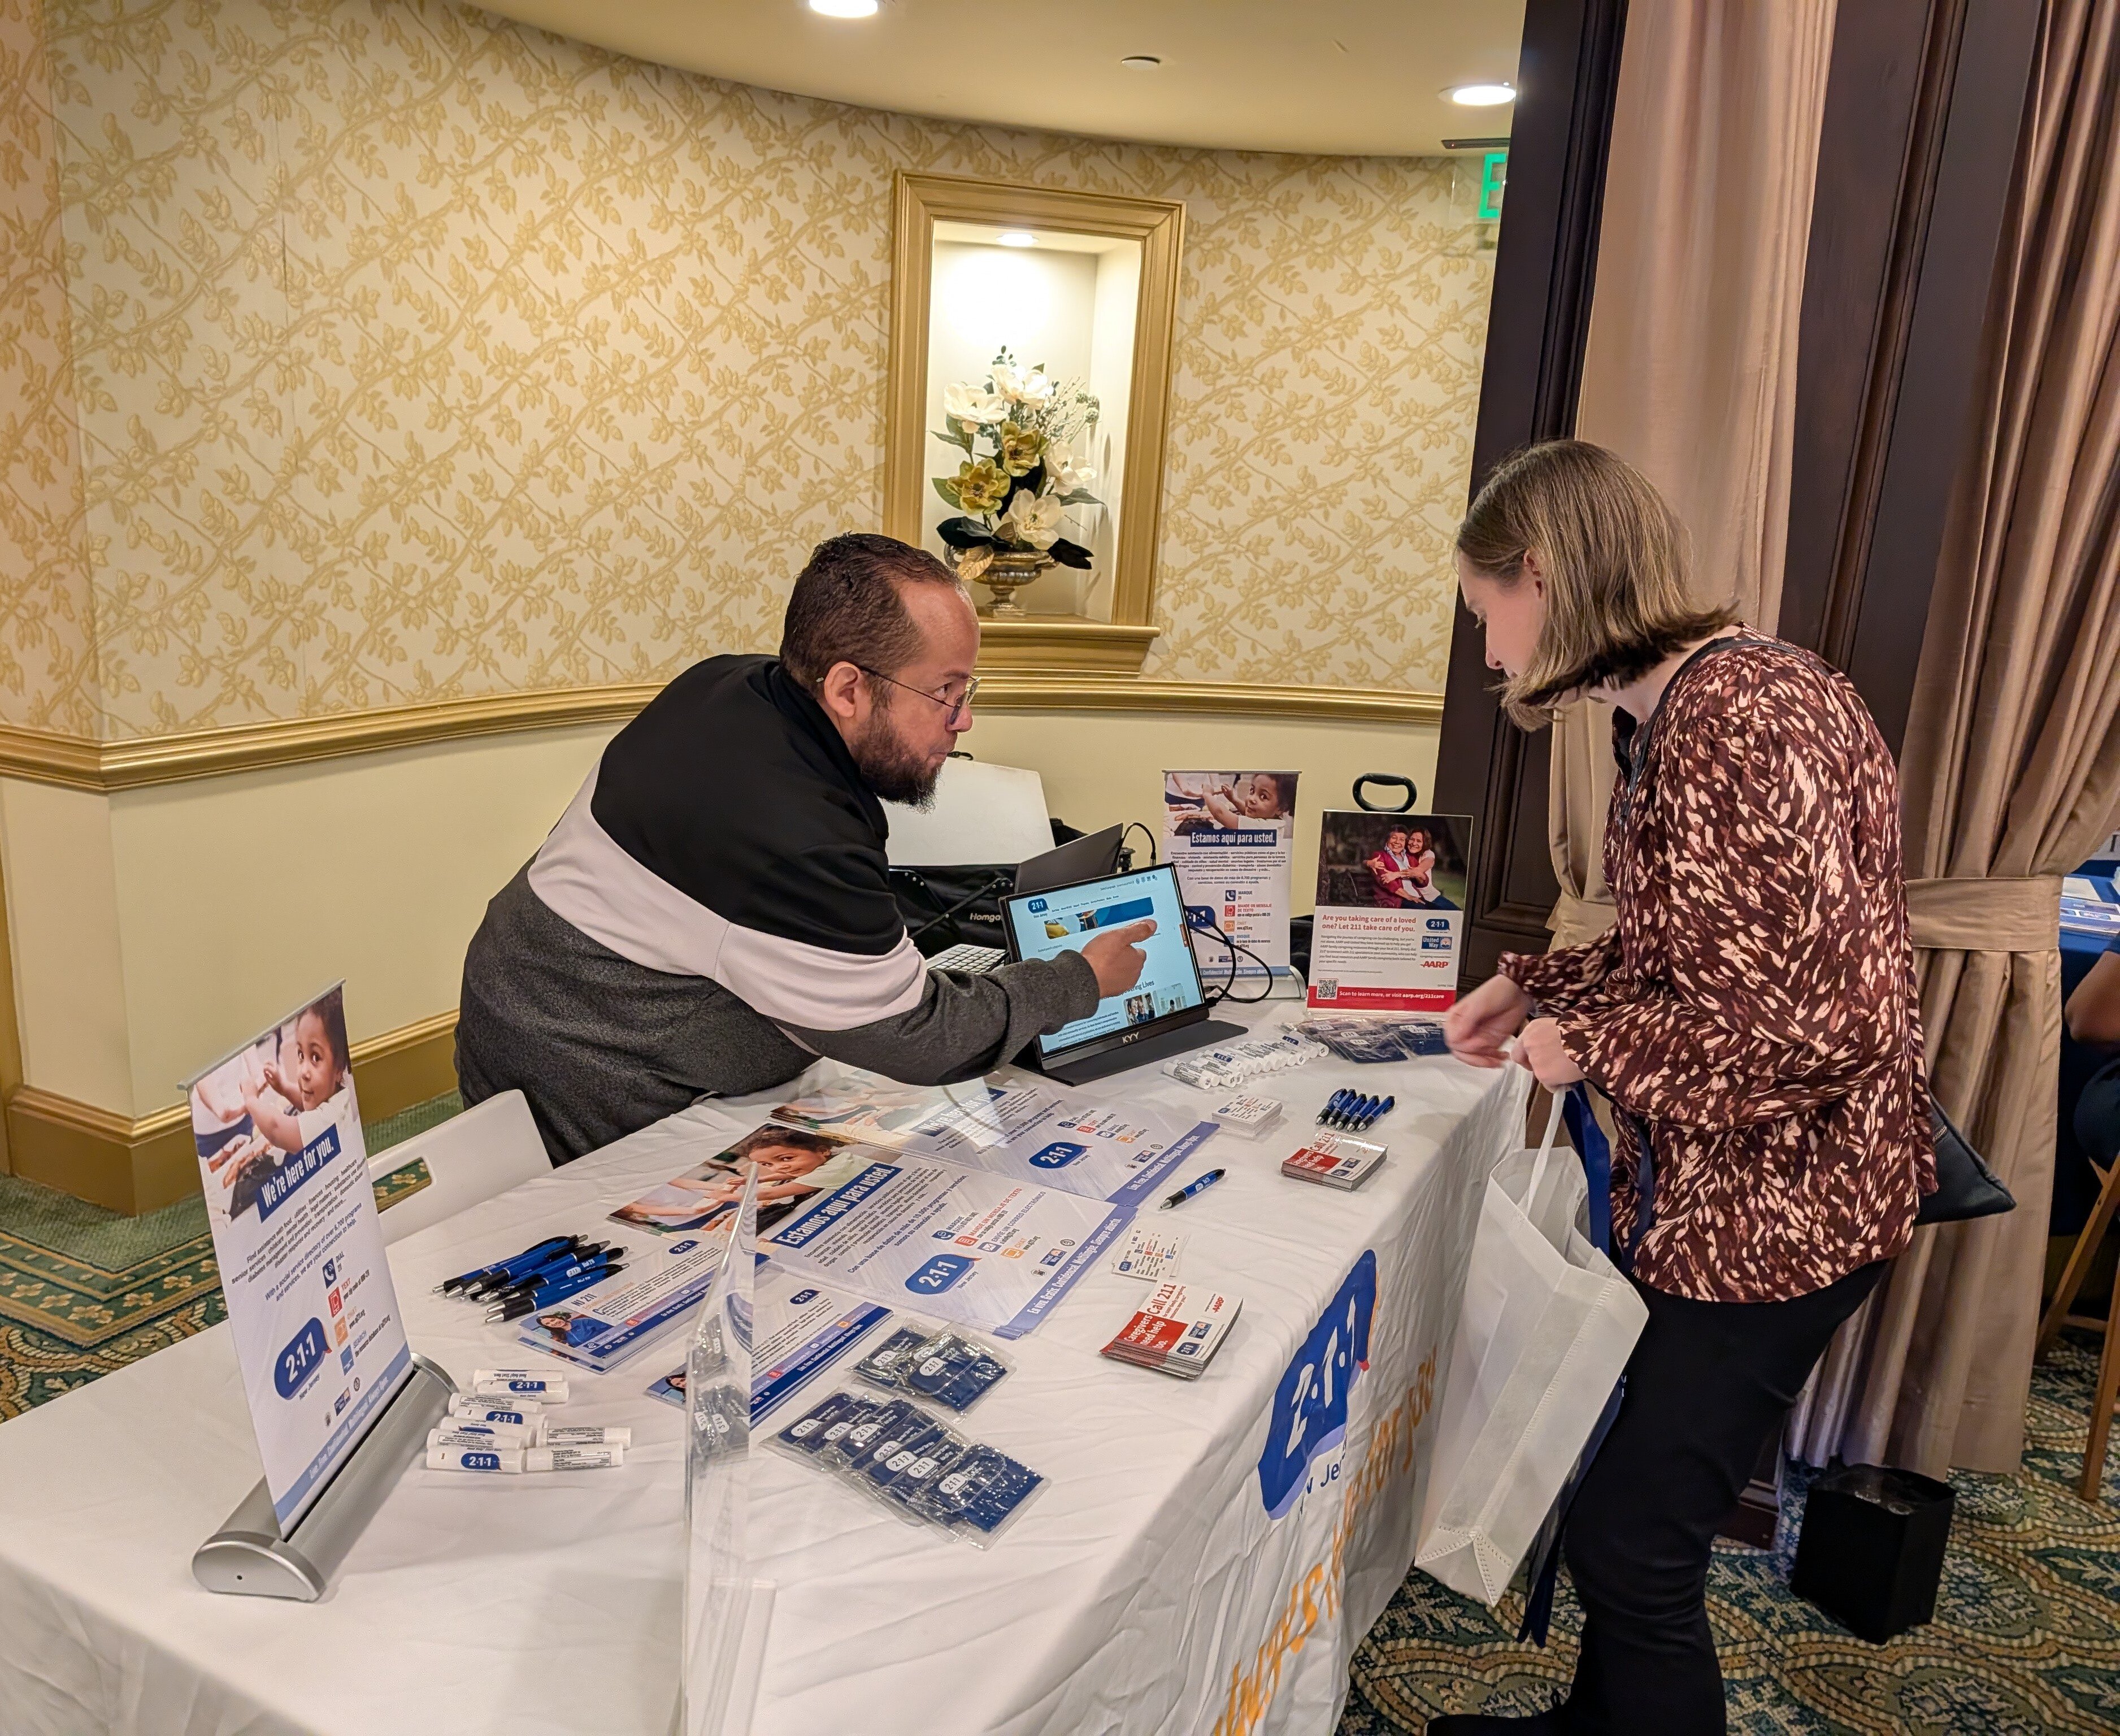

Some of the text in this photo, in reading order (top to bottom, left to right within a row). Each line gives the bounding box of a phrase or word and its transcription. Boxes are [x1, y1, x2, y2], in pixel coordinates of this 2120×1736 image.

[1192, 832, 1219, 843] Estamos
[1237, 835, 1253, 845] para
[1254, 832, 1275, 843] usted.
[1348, 915, 1369, 924] taking
[1142, 980, 1155, 988] Lives
[1122, 1032, 1140, 1044] KYY
[917, 1115, 954, 1132] We're
[939, 1104, 972, 1119] here
[957, 1099, 981, 1109] for
[1309, 1141, 1325, 1151] Call
[262, 1136, 334, 1208] We're here for you.
[776, 1166, 895, 1245] Estamos aquí para usted.
[864, 1249, 879, 1259] base
[882, 1235, 896, 1245] datos
[900, 1223, 911, 1231] más
[927, 1191, 948, 1208] programas
[949, 1175, 969, 1189] servicios,
[946, 1216, 965, 1230] MARQUE
[1007, 1213, 1024, 1227] CORREO
[894, 1234, 910, 1246] somos
[913, 1215, 932, 1230] conexión
[933, 1203, 948, 1213] ayuda.
[968, 1222, 985, 1236] MANDE
[232, 1269, 248, 1284] senior
[249, 1254, 266, 1271] services
[965, 1271, 979, 1284] Jersey
[580, 1292, 597, 1301] 211
[1146, 1283, 1177, 1314] Call 211
[1212, 1296, 1224, 1313] AARP
[1124, 1314, 1153, 1342] Caregivers
[1140, 1321, 1167, 1346] need help
[1153, 1340, 1168, 1349] too.
